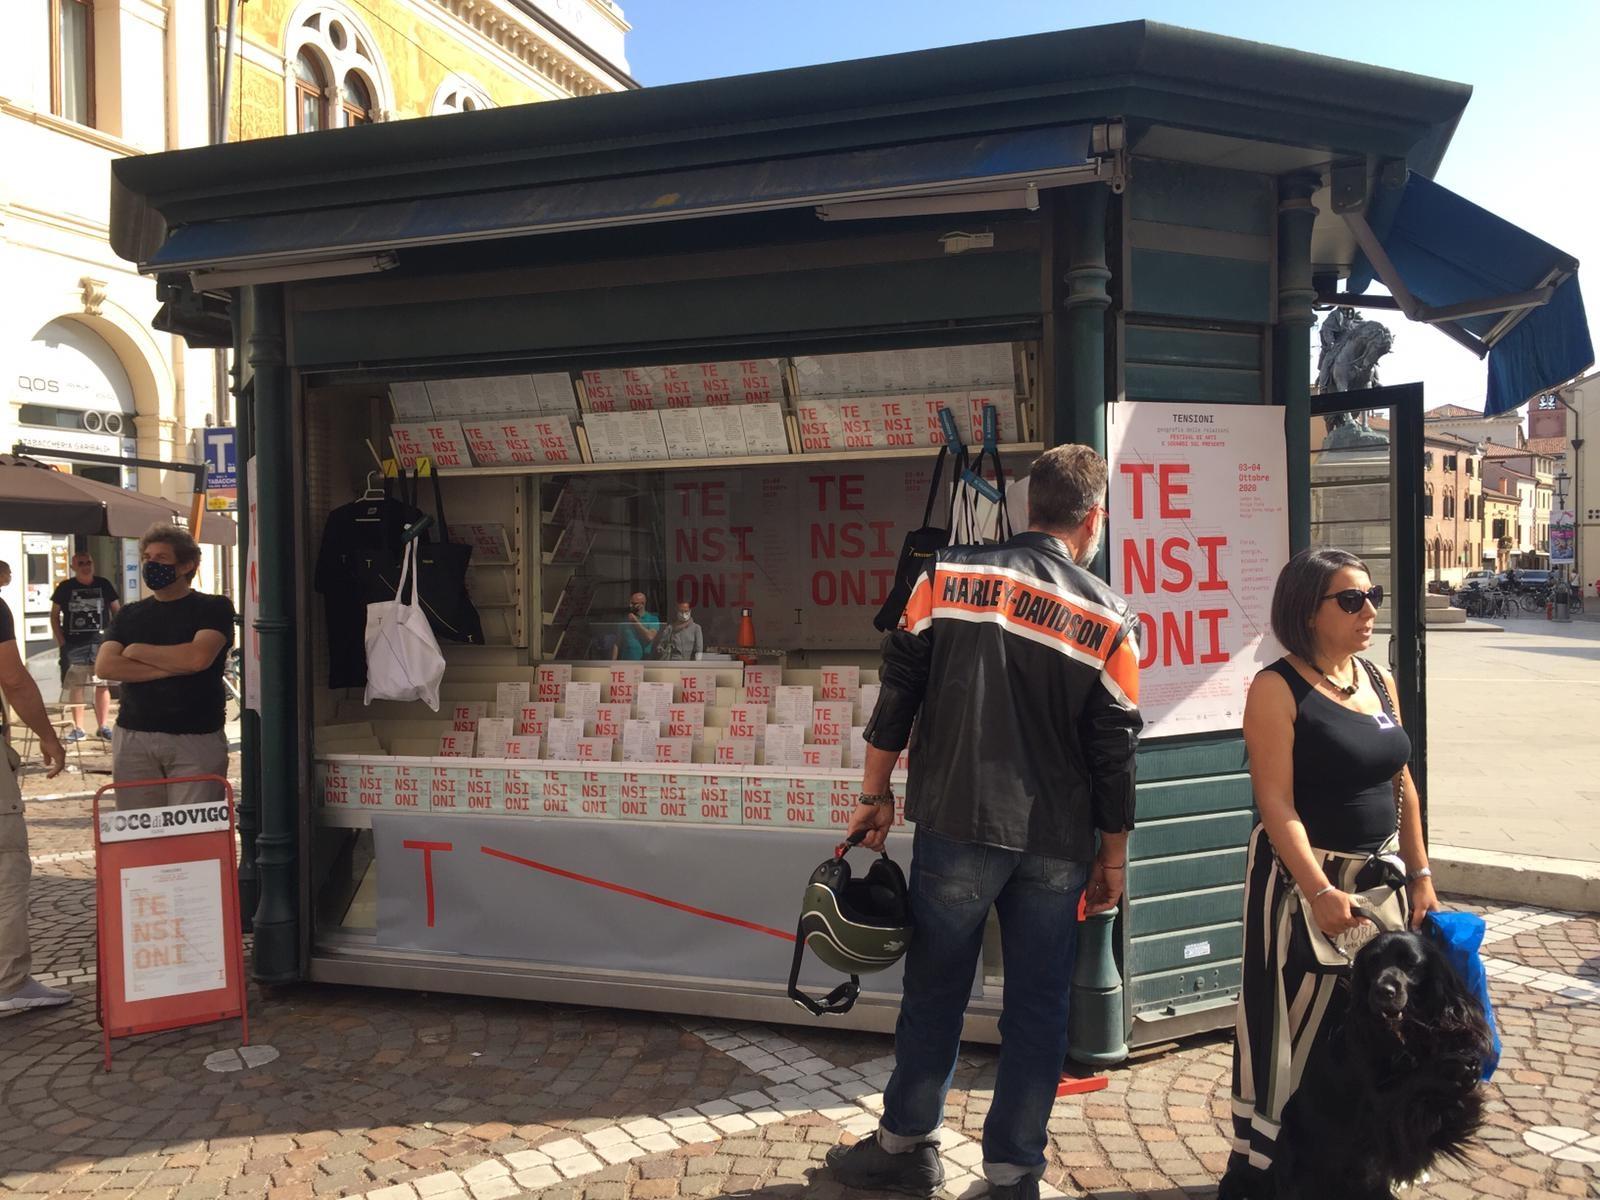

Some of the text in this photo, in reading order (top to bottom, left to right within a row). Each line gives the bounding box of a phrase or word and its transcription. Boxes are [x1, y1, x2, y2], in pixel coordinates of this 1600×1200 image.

[664, 368, 679, 379] TE
[702, 365, 717, 377] TE
[740, 362, 757, 374] TE
[585, 372, 600, 384] TE
[623, 370, 640, 382] TE
[665, 382, 689, 393] NSI
[704, 379, 728, 391] NSI
[743, 377, 768, 388] NSI
[588, 386, 613, 398] NSI
[627, 384, 651, 396] NSI
[668, 396, 692, 408] ONI
[707, 394, 730, 405] ONI
[745, 392, 769, 403] ONI
[592, 400, 614, 412] ONI
[630, 399, 653, 410] ONI
[882, 404, 900, 416] TE
[800, 409, 817, 419] TE
[842, 406, 859, 417] TE
[885, 418, 912, 430] NSI
[1173, 414, 1215, 423] TENSIONI
[536, 424, 552, 435] TE
[802, 423, 828, 434] NSI
[844, 420, 871, 432] NSI
[395, 430, 409, 441] TE
[428, 428, 444, 439] TE
[466, 429, 483, 438] TE
[502, 427, 518, 437] TE
[506, 439, 529, 449] NSI
[540, 437, 564, 448] NSI
[804, 438, 831, 449] ONI
[847, 436, 873, 447] ONI
[887, 433, 914, 445] ONI
[398, 444, 420, 454] NSI
[432, 441, 456, 452] NSI
[472, 441, 496, 450] NSI
[208, 434, 233, 472] T
[477, 453, 500, 463] ONI
[512, 452, 535, 462] ONI
[544, 451, 568, 461] ONI
[437, 455, 460, 465] ONI
[809, 475, 865, 511] TE
[1120, 463, 1191, 519] TE
[674, 481, 726, 517] TE
[675, 527, 754, 563] NSI
[810, 521, 896, 559] NSI
[1123, 536, 1228, 594] NSI
[676, 572, 754, 609] ONI
[811, 569, 896, 606] ONI
[942, 576, 1109, 651] HARLEY-DAVIDSON
[541, 671, 554, 681] TE
[611, 672, 624, 682] TE
[747, 672, 762, 683] TE
[823, 673, 838, 684] TE
[682, 677, 696, 688] TE
[539, 684, 560, 695] NSI
[610, 686, 632, 696] NSI
[746, 687, 769, 698] NSI
[822, 688, 846, 699] NSI
[682, 692, 704, 702] NSI
[456, 708, 469, 719] TE
[522, 709, 536, 720] TE
[597, 710, 611, 721] TE
[670, 710, 685, 721] TE
[731, 710, 746, 722] TE
[815, 709, 831, 720] TE
[454, 722, 475, 732] NSI
[521, 723, 542, 733] NSI
[596, 724, 618, 735] NSI
[669, 725, 692, 736] NSI
[730, 725, 753, 736] NSI
[814, 724, 839, 735] NSI
[442, 738, 456, 748] TE
[506, 743, 520, 753] TE
[578, 744, 592, 755] TE
[656, 745, 671, 756] TE
[718, 747, 734, 758] TE
[804, 752, 820, 763] TE
[326, 765, 340, 775] TE
[360, 765, 374, 775] TE
[397, 766, 410, 776] TE
[434, 767, 447, 777] TE
[469, 767, 483, 777] TE
[507, 768, 521, 779] TE
[544, 770, 559, 780] TE
[583, 771, 598, 781] TE
[623, 773, 638, 782] TE
[662, 774, 677, 784] TE
[703, 775, 718, 785] TE
[326, 777, 347, 789] NSI
[360, 778, 382, 790] NSI
[395, 779, 418, 791] NSI
[432, 780, 455, 792] NSI
[468, 781, 491, 793] NSI
[747, 777, 762, 787] TE
[789, 778, 805, 788] TE
[833, 780, 849, 790] TE
[505, 783, 529, 795] NSI
[543, 784, 567, 796] NSI
[581, 785, 606, 798] NSI
[621, 786, 647, 798] NSI
[660, 787, 686, 800] NSI
[326, 792, 348, 804] ONI
[360, 793, 382, 805] ONI
[395, 794, 418, 806] ONI
[701, 789, 728, 801] NSI
[744, 791, 771, 804] NSI
[787, 792, 815, 805] NSI
[831, 793, 859, 807] NSI
[433, 795, 456, 807] ONI
[468, 796, 492, 809] ONI
[505, 798, 529, 810] ONI
[543, 800, 568, 812] ONI
[582, 801, 607, 814] ONI
[622, 802, 647, 815] ONI
[660, 803, 687, 816] ONI
[702, 805, 728, 818] ONI
[745, 806, 772, 820] ONI
[162, 805, 229, 828] ROVIGO
[787, 808, 815, 822] ONI
[132, 895, 168, 917] TE
[132, 918, 185, 943] NSI
[133, 943, 186, 970] ONI
